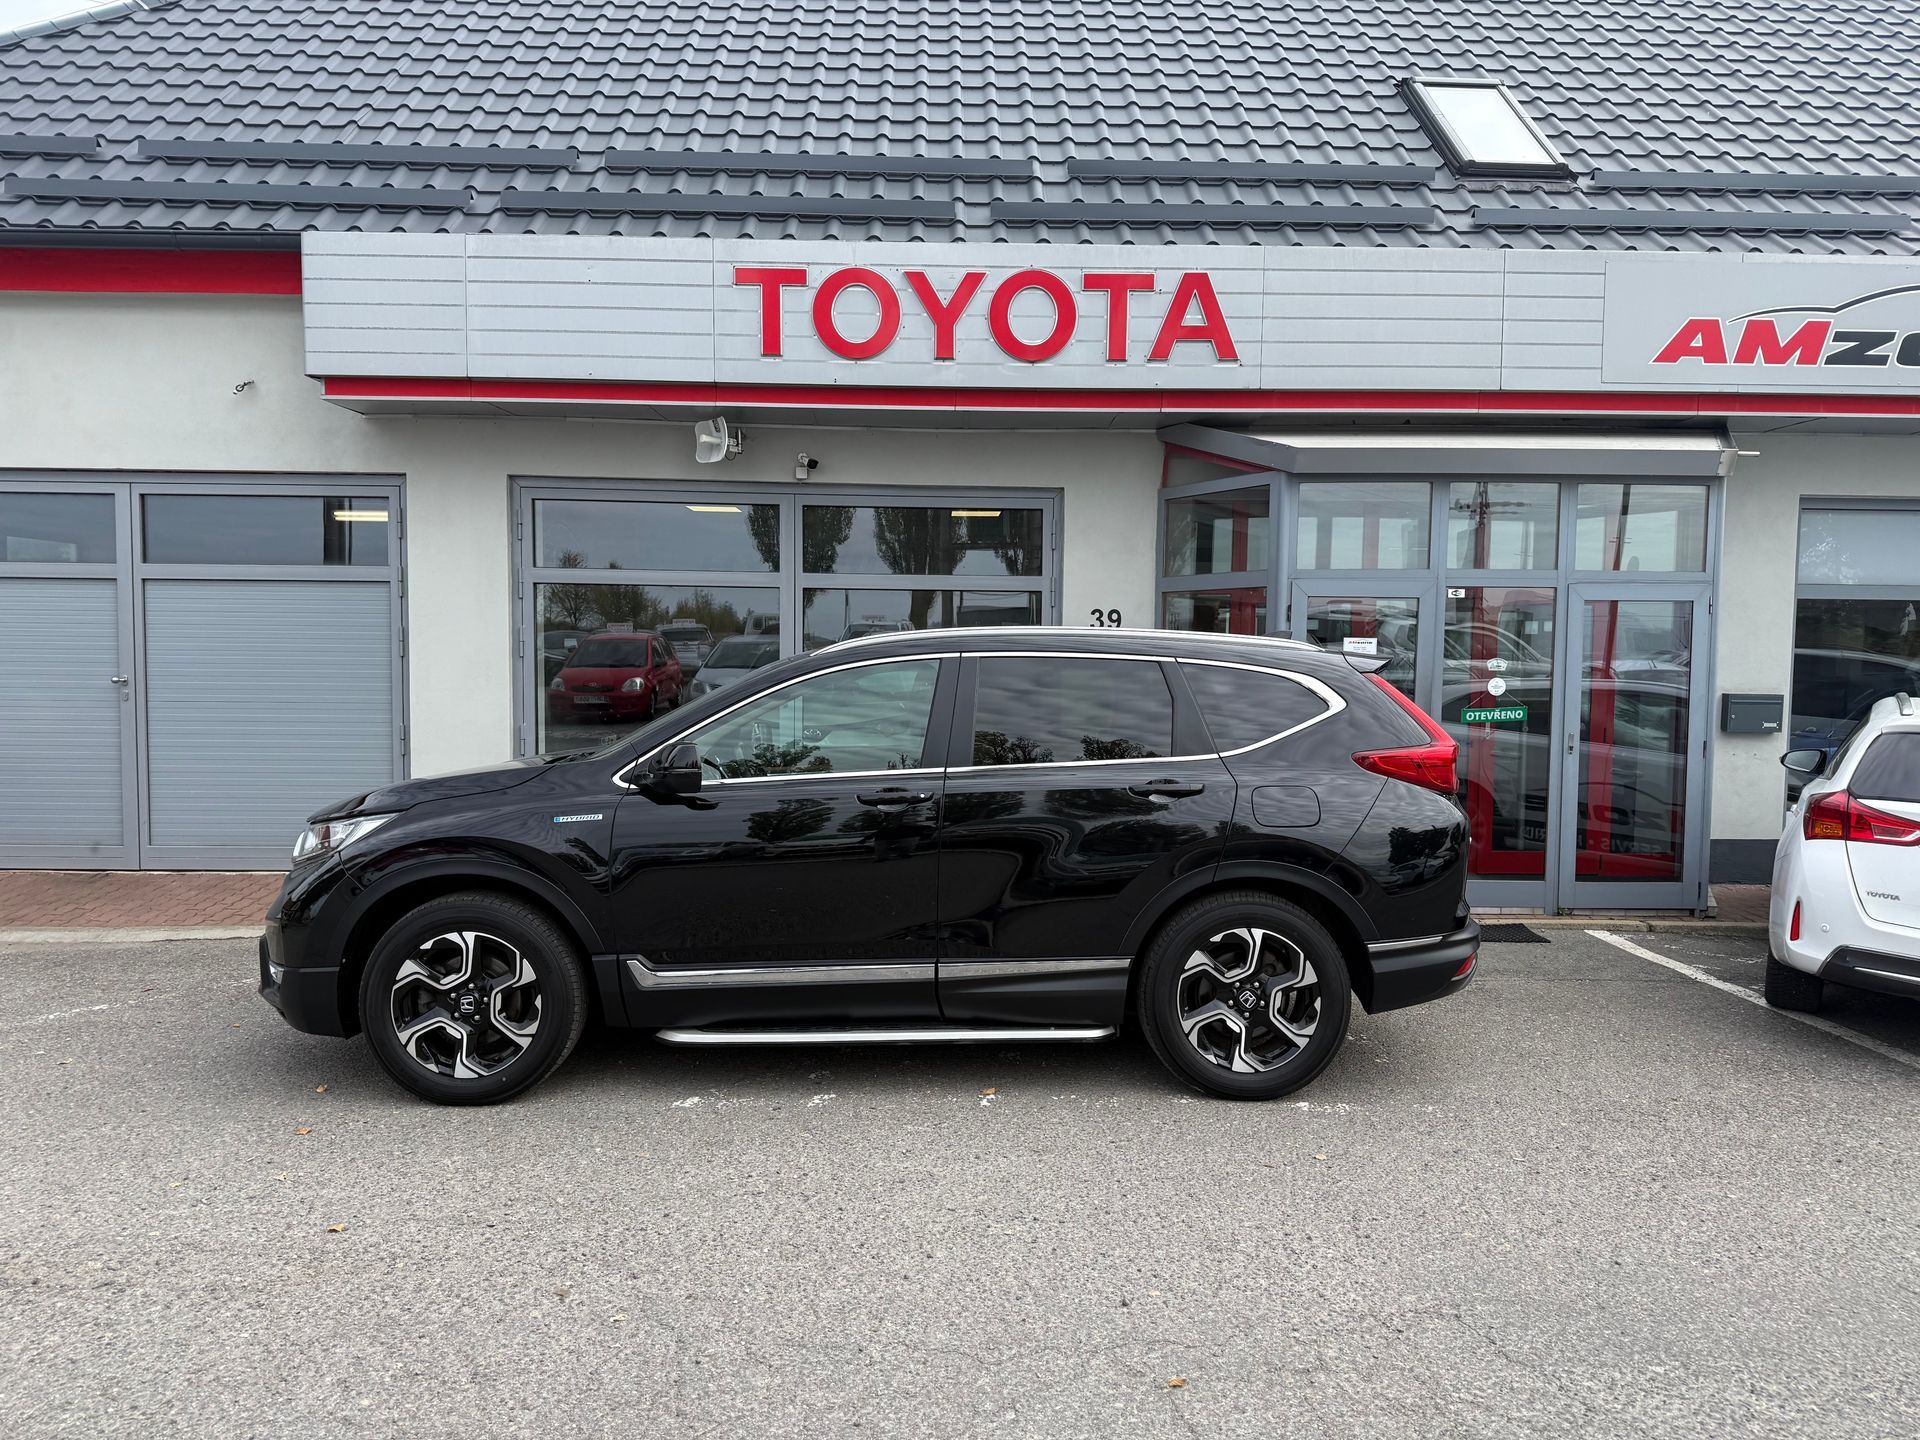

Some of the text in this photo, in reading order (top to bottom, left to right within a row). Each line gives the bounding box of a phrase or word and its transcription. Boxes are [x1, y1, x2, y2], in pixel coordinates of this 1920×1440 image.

[733, 265, 1240, 362] TOYOTA
[1089, 608, 1122, 628] 39
[1465, 709, 1524, 721] OTEVŘENO
[1865, 890, 1901, 901] TOYOTA
